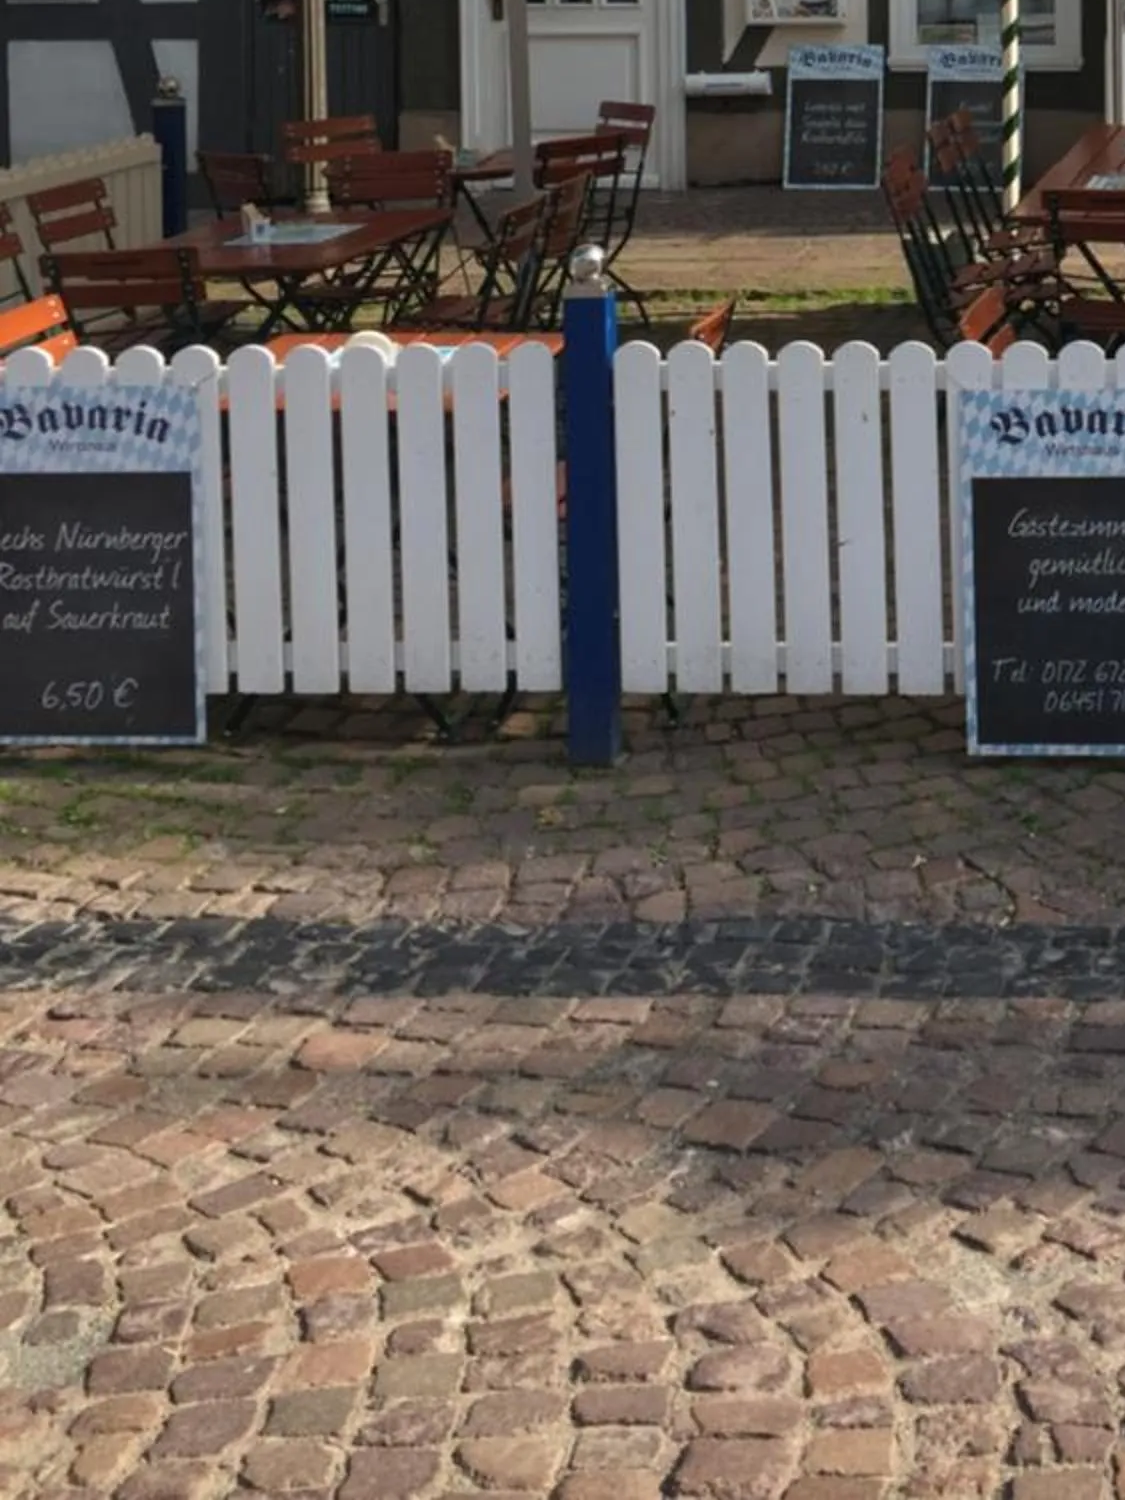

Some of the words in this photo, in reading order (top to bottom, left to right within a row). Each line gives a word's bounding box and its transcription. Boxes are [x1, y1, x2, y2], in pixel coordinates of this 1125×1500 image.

[0, 400, 171, 444] Bavaria
[55, 521, 189, 564] Nürnberger
[3, 599, 42, 634] auf
[47, 599, 172, 630] Sauerkraut
[1017, 591, 1062, 614] und
[1041, 659, 1087, 684] 0172
[41, 681, 104, 711] 6,50
[114, 677, 139, 708] €
